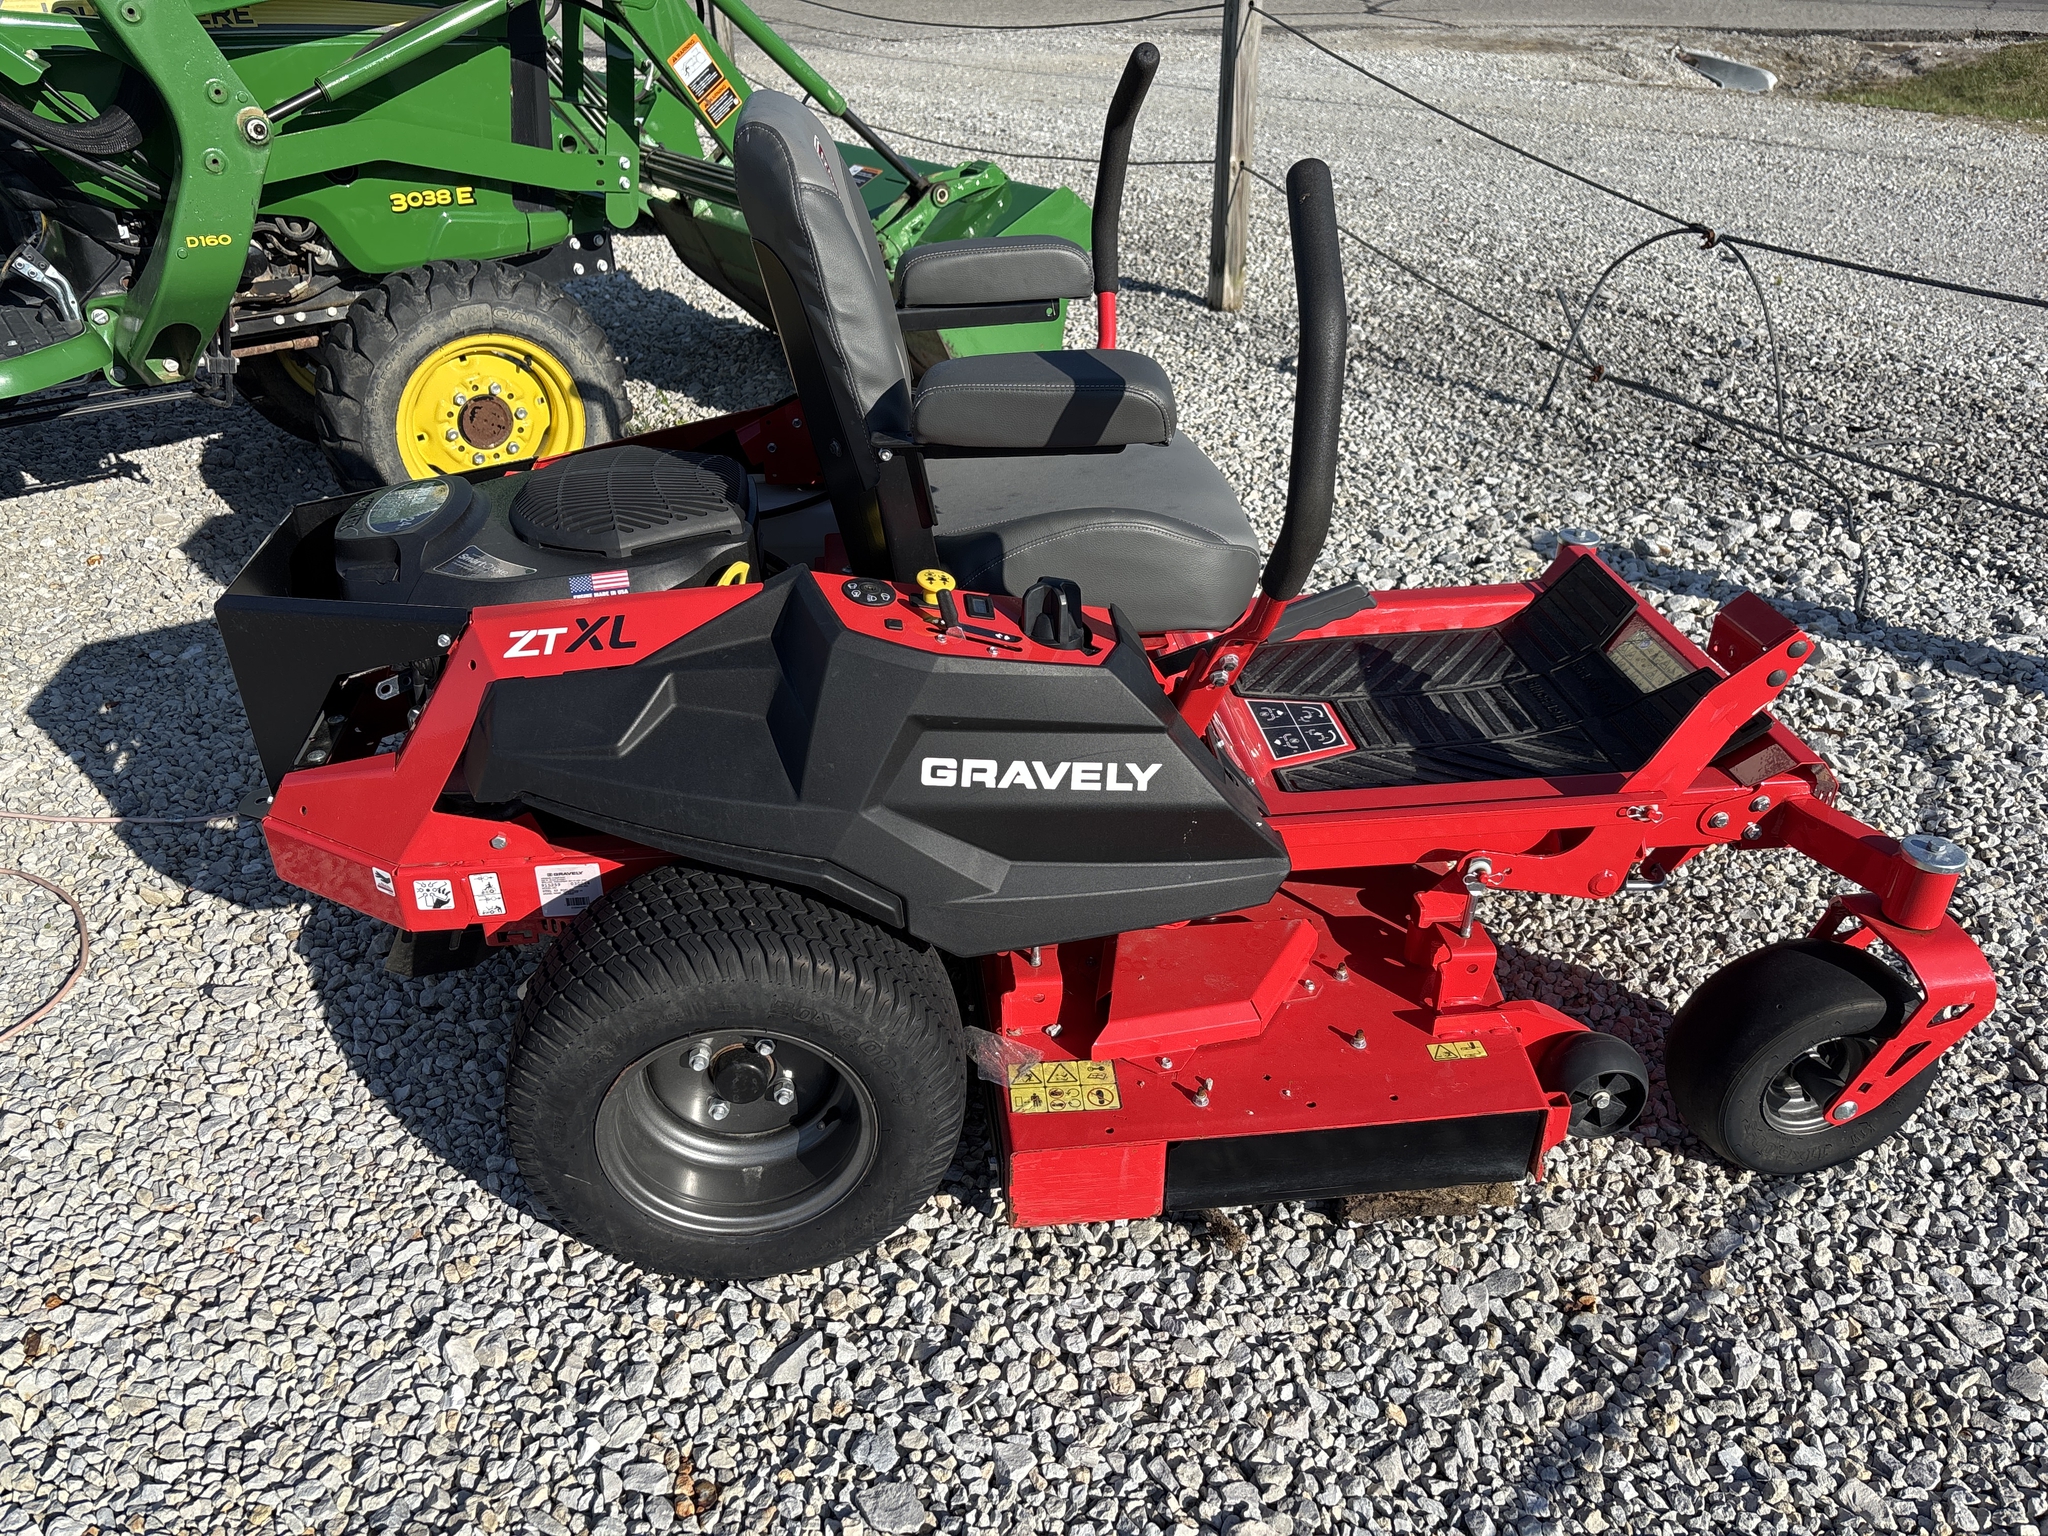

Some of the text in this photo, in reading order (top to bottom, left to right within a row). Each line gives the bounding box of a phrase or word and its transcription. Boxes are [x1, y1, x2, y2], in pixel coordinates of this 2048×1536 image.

[389, 186, 475, 213] 3038 E
[185, 234, 232, 249] D160
[493, 307, 594, 366] GALAXY
[921, 757, 1163, 792] GRAVELY
